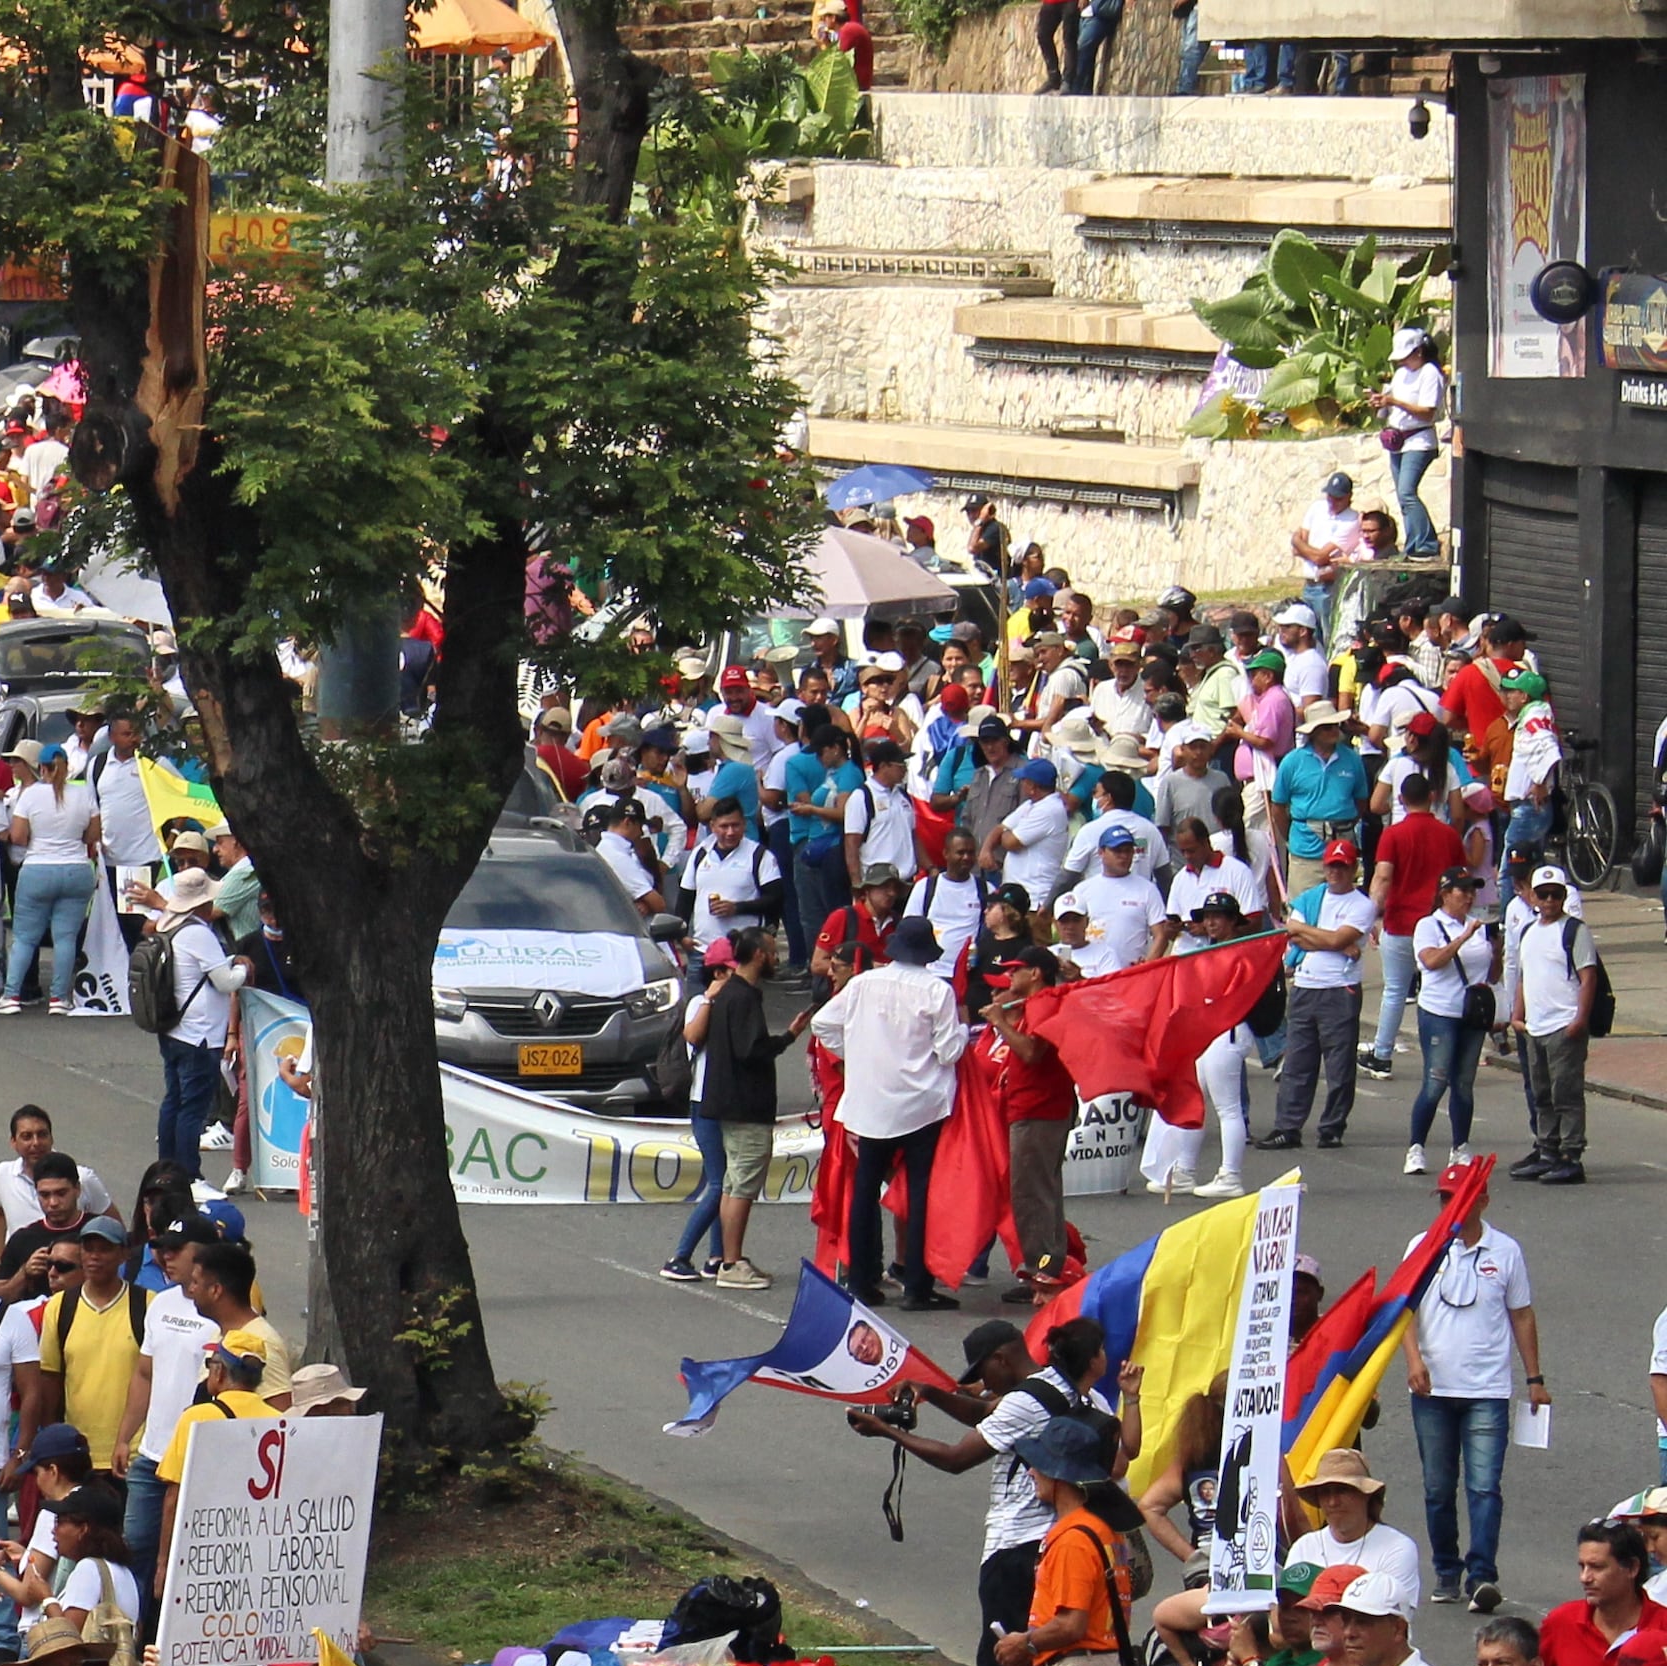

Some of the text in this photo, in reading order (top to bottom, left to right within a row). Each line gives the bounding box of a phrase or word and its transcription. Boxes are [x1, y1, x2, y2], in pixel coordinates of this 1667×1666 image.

[1621, 378, 1648, 404] Drinks
[522, 1049, 579, 1068] JSZ 026
[572, 1128, 706, 1203] 10
[471, 1182, 538, 1198] abandona
[190, 1495, 355, 1539] REFORMA A LA SALUD
[187, 1535, 345, 1576] REFORMA LABORAL
[185, 1573, 350, 1614] REFORMA PENSIONAL
[202, 1609, 304, 1638] COLOMBIA
[171, 1638, 248, 1666] POTENCIA
